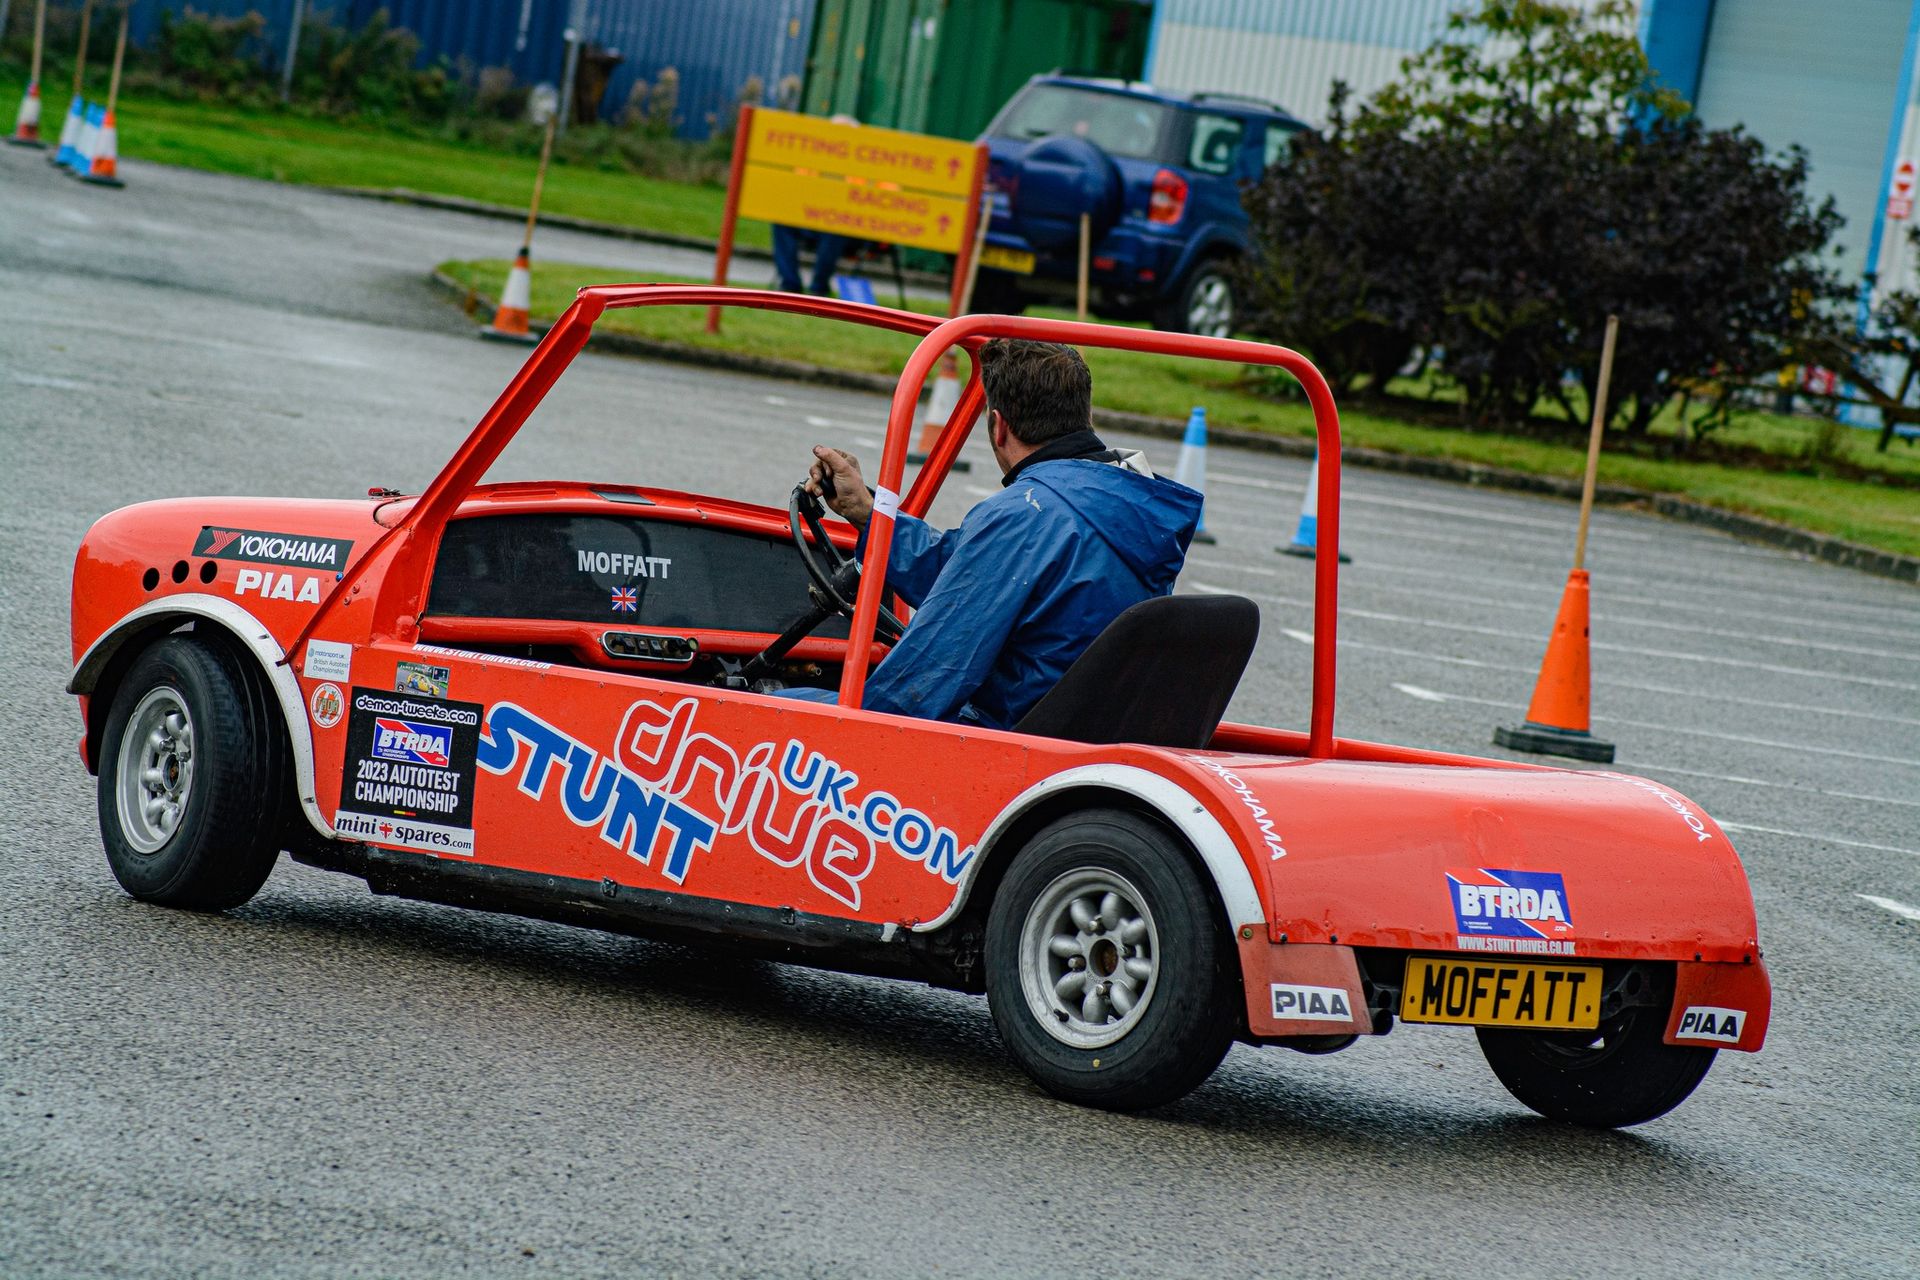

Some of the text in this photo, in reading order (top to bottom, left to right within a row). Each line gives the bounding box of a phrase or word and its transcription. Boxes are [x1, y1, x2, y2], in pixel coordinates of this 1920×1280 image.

[766, 129, 937, 171] FITTING CENTRE
[849, 189, 929, 214] RACING
[804, 206, 925, 237] WORKSHOP
[238, 536, 337, 564] YOKOHAMA
[578, 550, 671, 579] MOFFATT
[235, 569, 320, 604] PIAA
[356, 695, 477, 725] demon-tweeks.com
[377, 729, 445, 755] BTRDA
[357, 759, 460, 793] 2023 AUTOTEST
[355, 781, 459, 813] CHAMPIONSHIP
[477, 701, 719, 886] STUNT
[615, 698, 876, 912] drive
[336, 816, 472, 849] mini spares.com
[1458, 884, 1566, 922] BTRDA
[1275, 991, 1349, 1016] PIAA
[1420, 964, 1586, 1022] MOFFATT
[1681, 1012, 1738, 1037] PIAA
